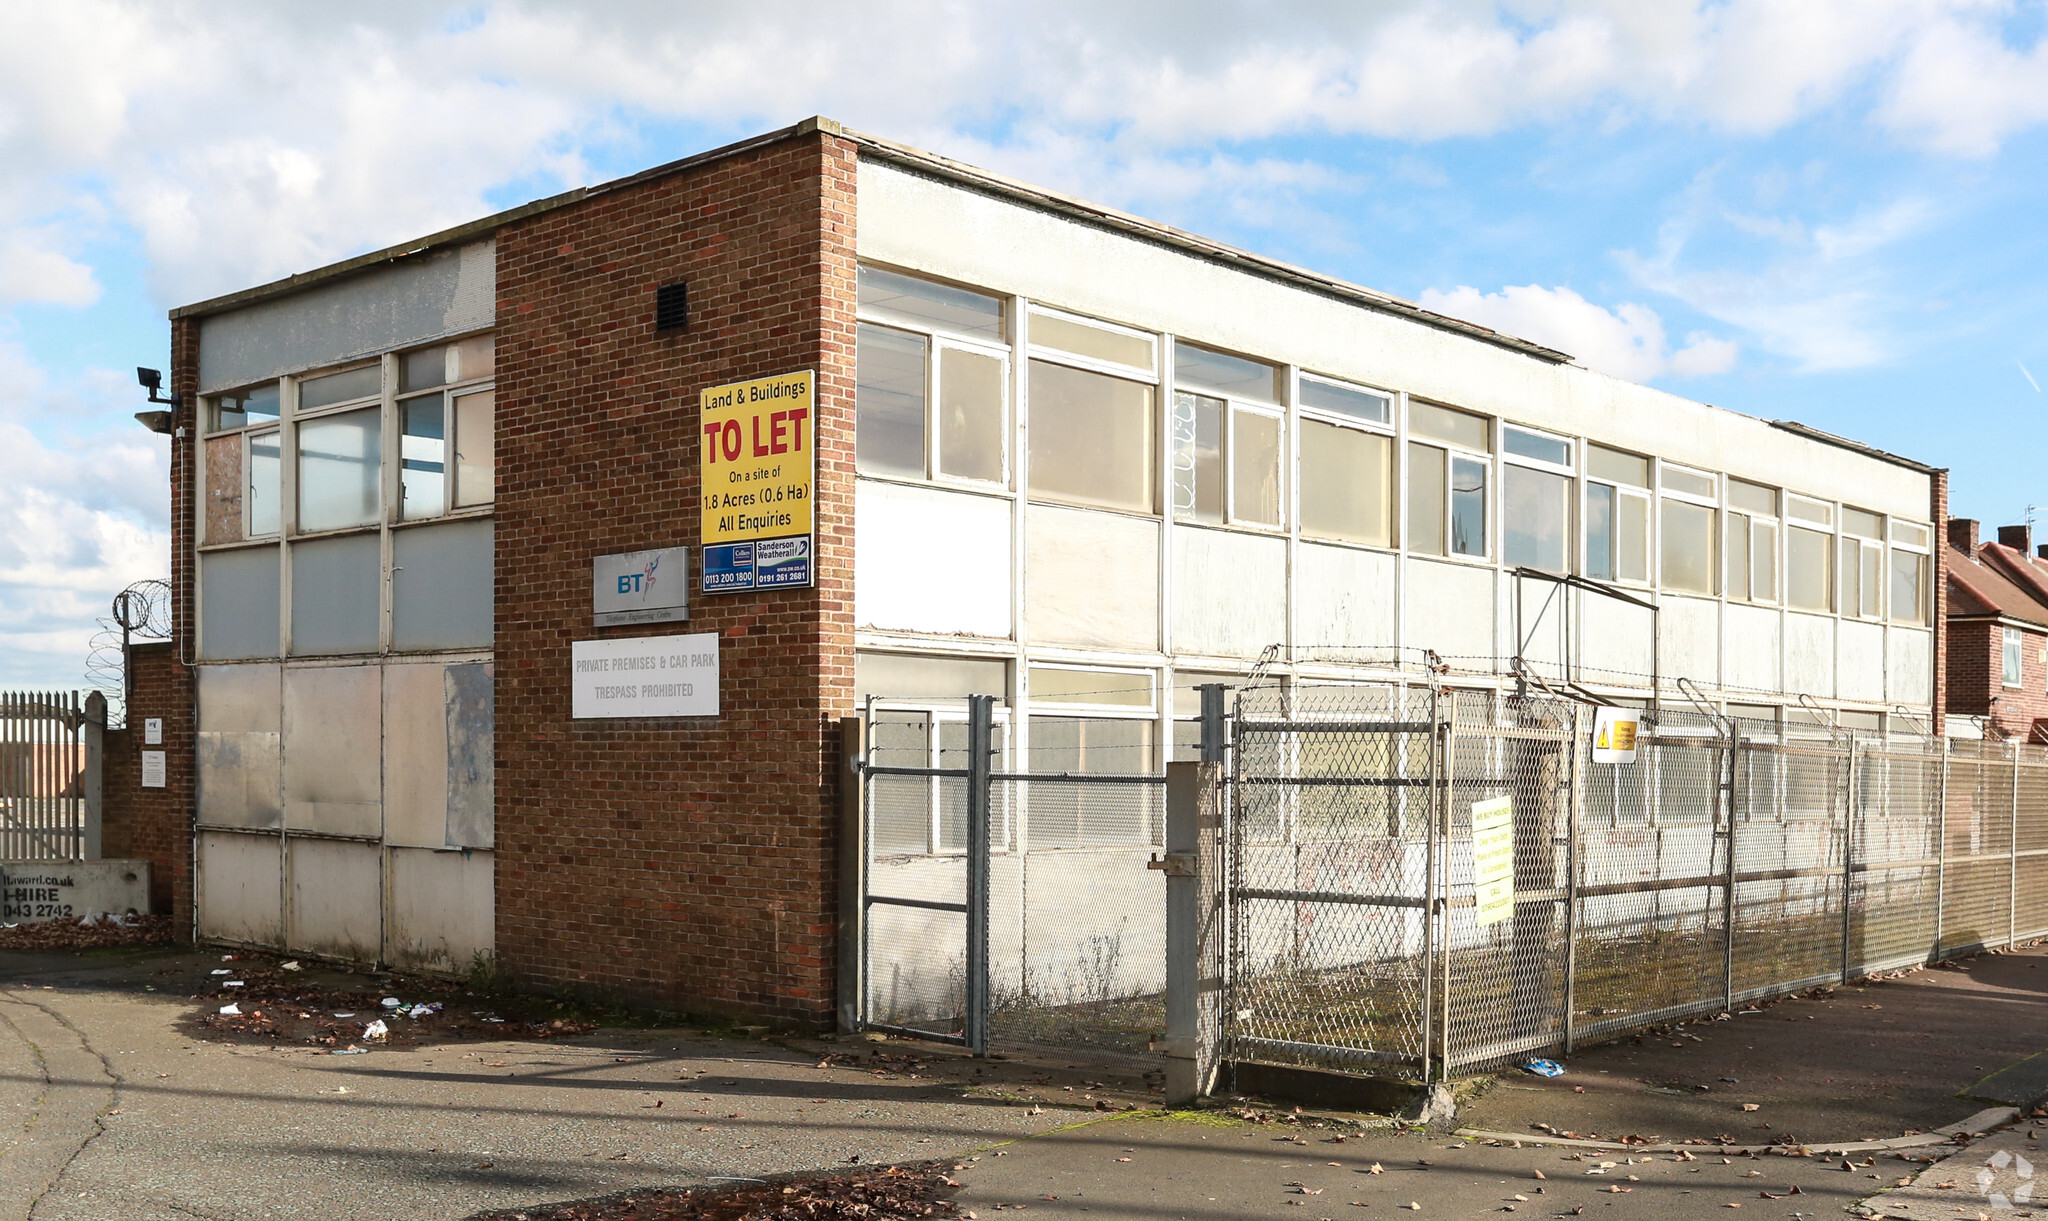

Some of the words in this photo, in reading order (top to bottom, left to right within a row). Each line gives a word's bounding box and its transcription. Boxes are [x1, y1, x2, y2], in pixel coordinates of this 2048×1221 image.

[705, 391, 732, 410] Land
[737, 389, 745, 404] &
[751, 381, 805, 402] Buildings
[704, 419, 742, 464] TO
[752, 408, 808, 457] LET
[729, 471, 742, 483] On
[745, 472, 750, 481] a
[753, 468, 769, 480] site
[772, 465, 781, 477] of
[704, 494, 718, 510] 1.8
[722, 493, 755, 508] Acres
[760, 486, 783, 503] (0.6
[787, 483, 809, 500] Ha)
[718, 515, 734, 532] All
[738, 510, 791, 533] Enquiries
[757, 541, 795, 551] Sanderson
[757, 549, 795, 559] Weatherall
[618, 574, 644, 594] BT
[705, 574, 719, 584] 0113
[721, 573, 735, 583] 200
[736, 572, 752, 582] 1800
[759, 574, 775, 583] 0191
[776, 573, 788, 581] 261
[790, 572, 805, 580] 2681
[576, 659, 609, 672] PRIVATE
[612, 656, 656, 671] PREMISES
[660, 656, 666, 668] &
[669, 655, 688, 668] CAR
[691, 653, 715, 667] PARK
[595, 685, 637, 699] TRESPASS
[641, 683, 694, 698] PROHIBITED
[36, 904, 73, 917] 2742
